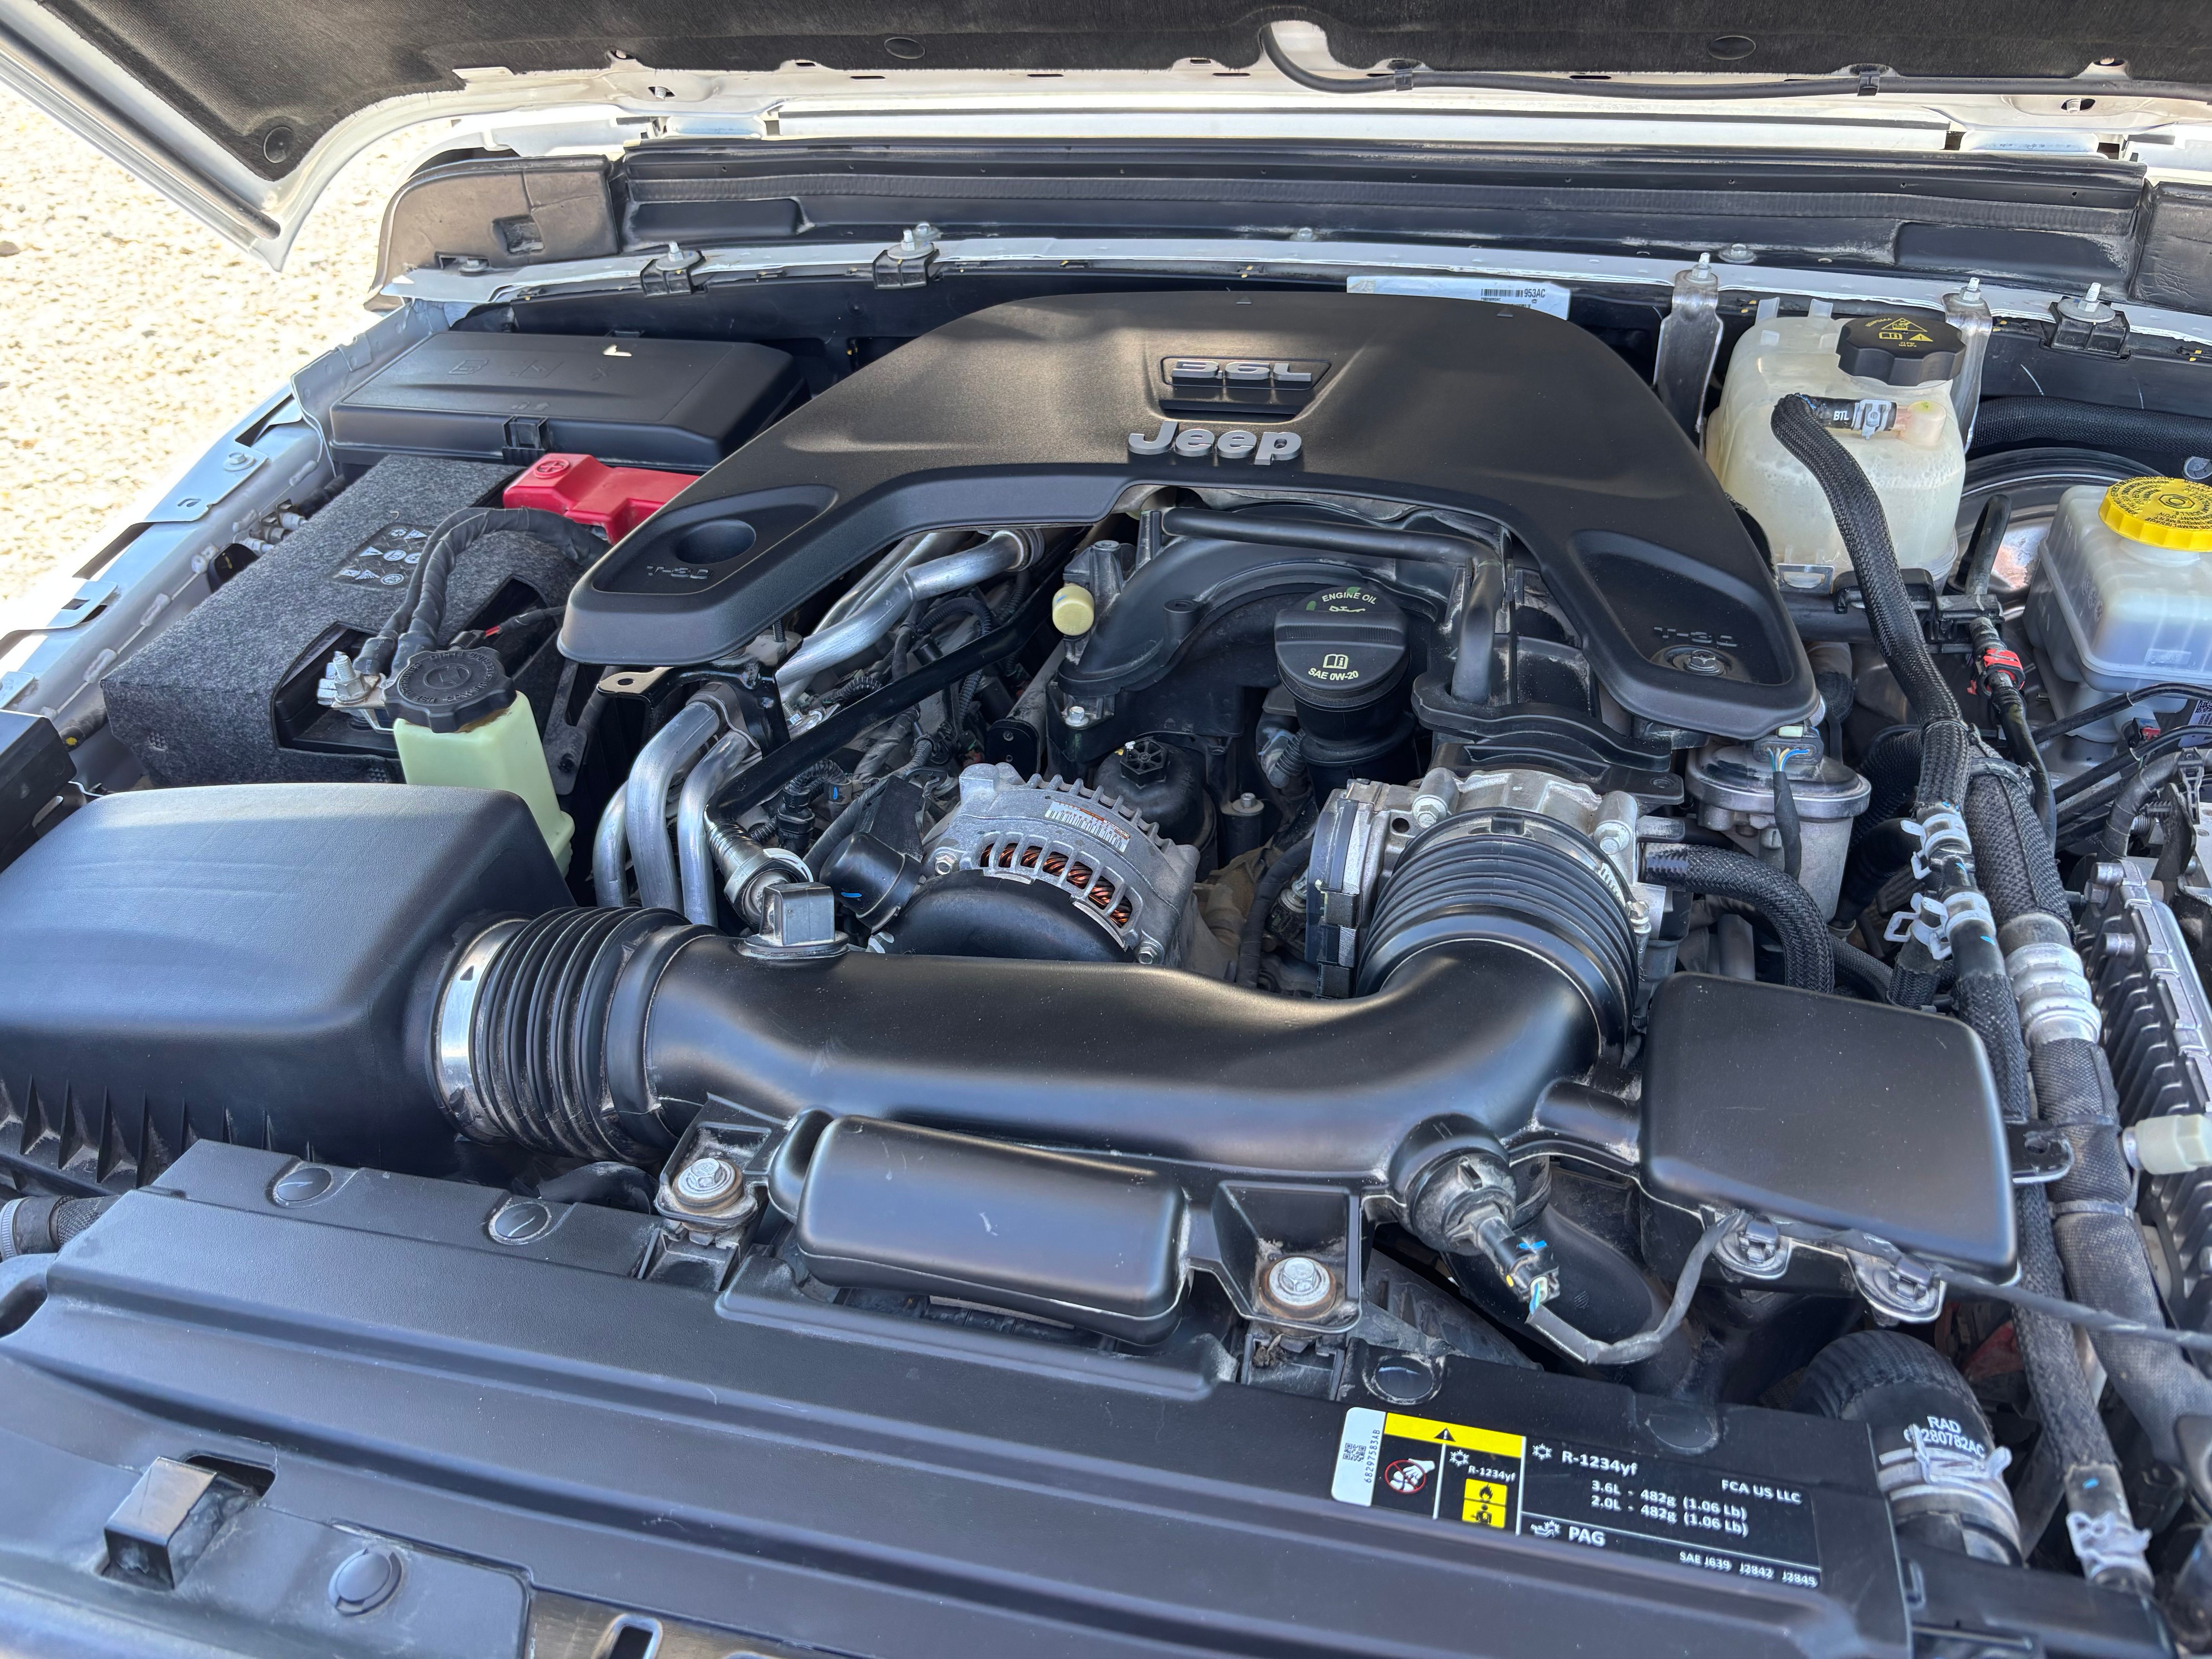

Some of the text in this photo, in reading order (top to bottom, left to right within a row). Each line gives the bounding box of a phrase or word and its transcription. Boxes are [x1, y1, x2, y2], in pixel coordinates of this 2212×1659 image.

[1524, 289, 1546, 298] 953AC
[1171, 359, 1312, 382] 3.6L
[1833, 410, 1850, 421] BTL
[1127, 421, 1303, 466] Jeep
[2145, 517, 2199, 529] REMPLISSAGE
[2154, 515, 2205, 526] UNIQUEMENT
[647, 565, 713, 579] T-30
[1321, 591, 1377, 605] ENGINE OIL
[1653, 626, 1738, 647] T-30
[1308, 667, 1358, 680] SAE 0W-20
[1927, 1416, 1961, 1434] RAD
[1364, 1429, 1380, 1483] 68297583AB
[1561, 1450, 1638, 1477] R-1234yf
[1468, 1465, 1516, 1482] R-1234yf
[1592, 1480, 1621, 1496] 3.6L
[1640, 1489, 1677, 1508] 482g
[1683, 1496, 1721, 1514] (1.06
[1724, 1504, 1747, 1521] Lb)
[1721, 1479, 1802, 1504] FCA US LLC
[1591, 1495, 1621, 1511] 2.0L
[1640, 1504, 1678, 1525] 482g
[1683, 1511, 1722, 1530] (1.06
[1724, 1520, 1749, 1538] Lb)
[1568, 1526, 1607, 1547] PAG
[1679, 1551, 1819, 1588] SAE J639 J2842 J2845
